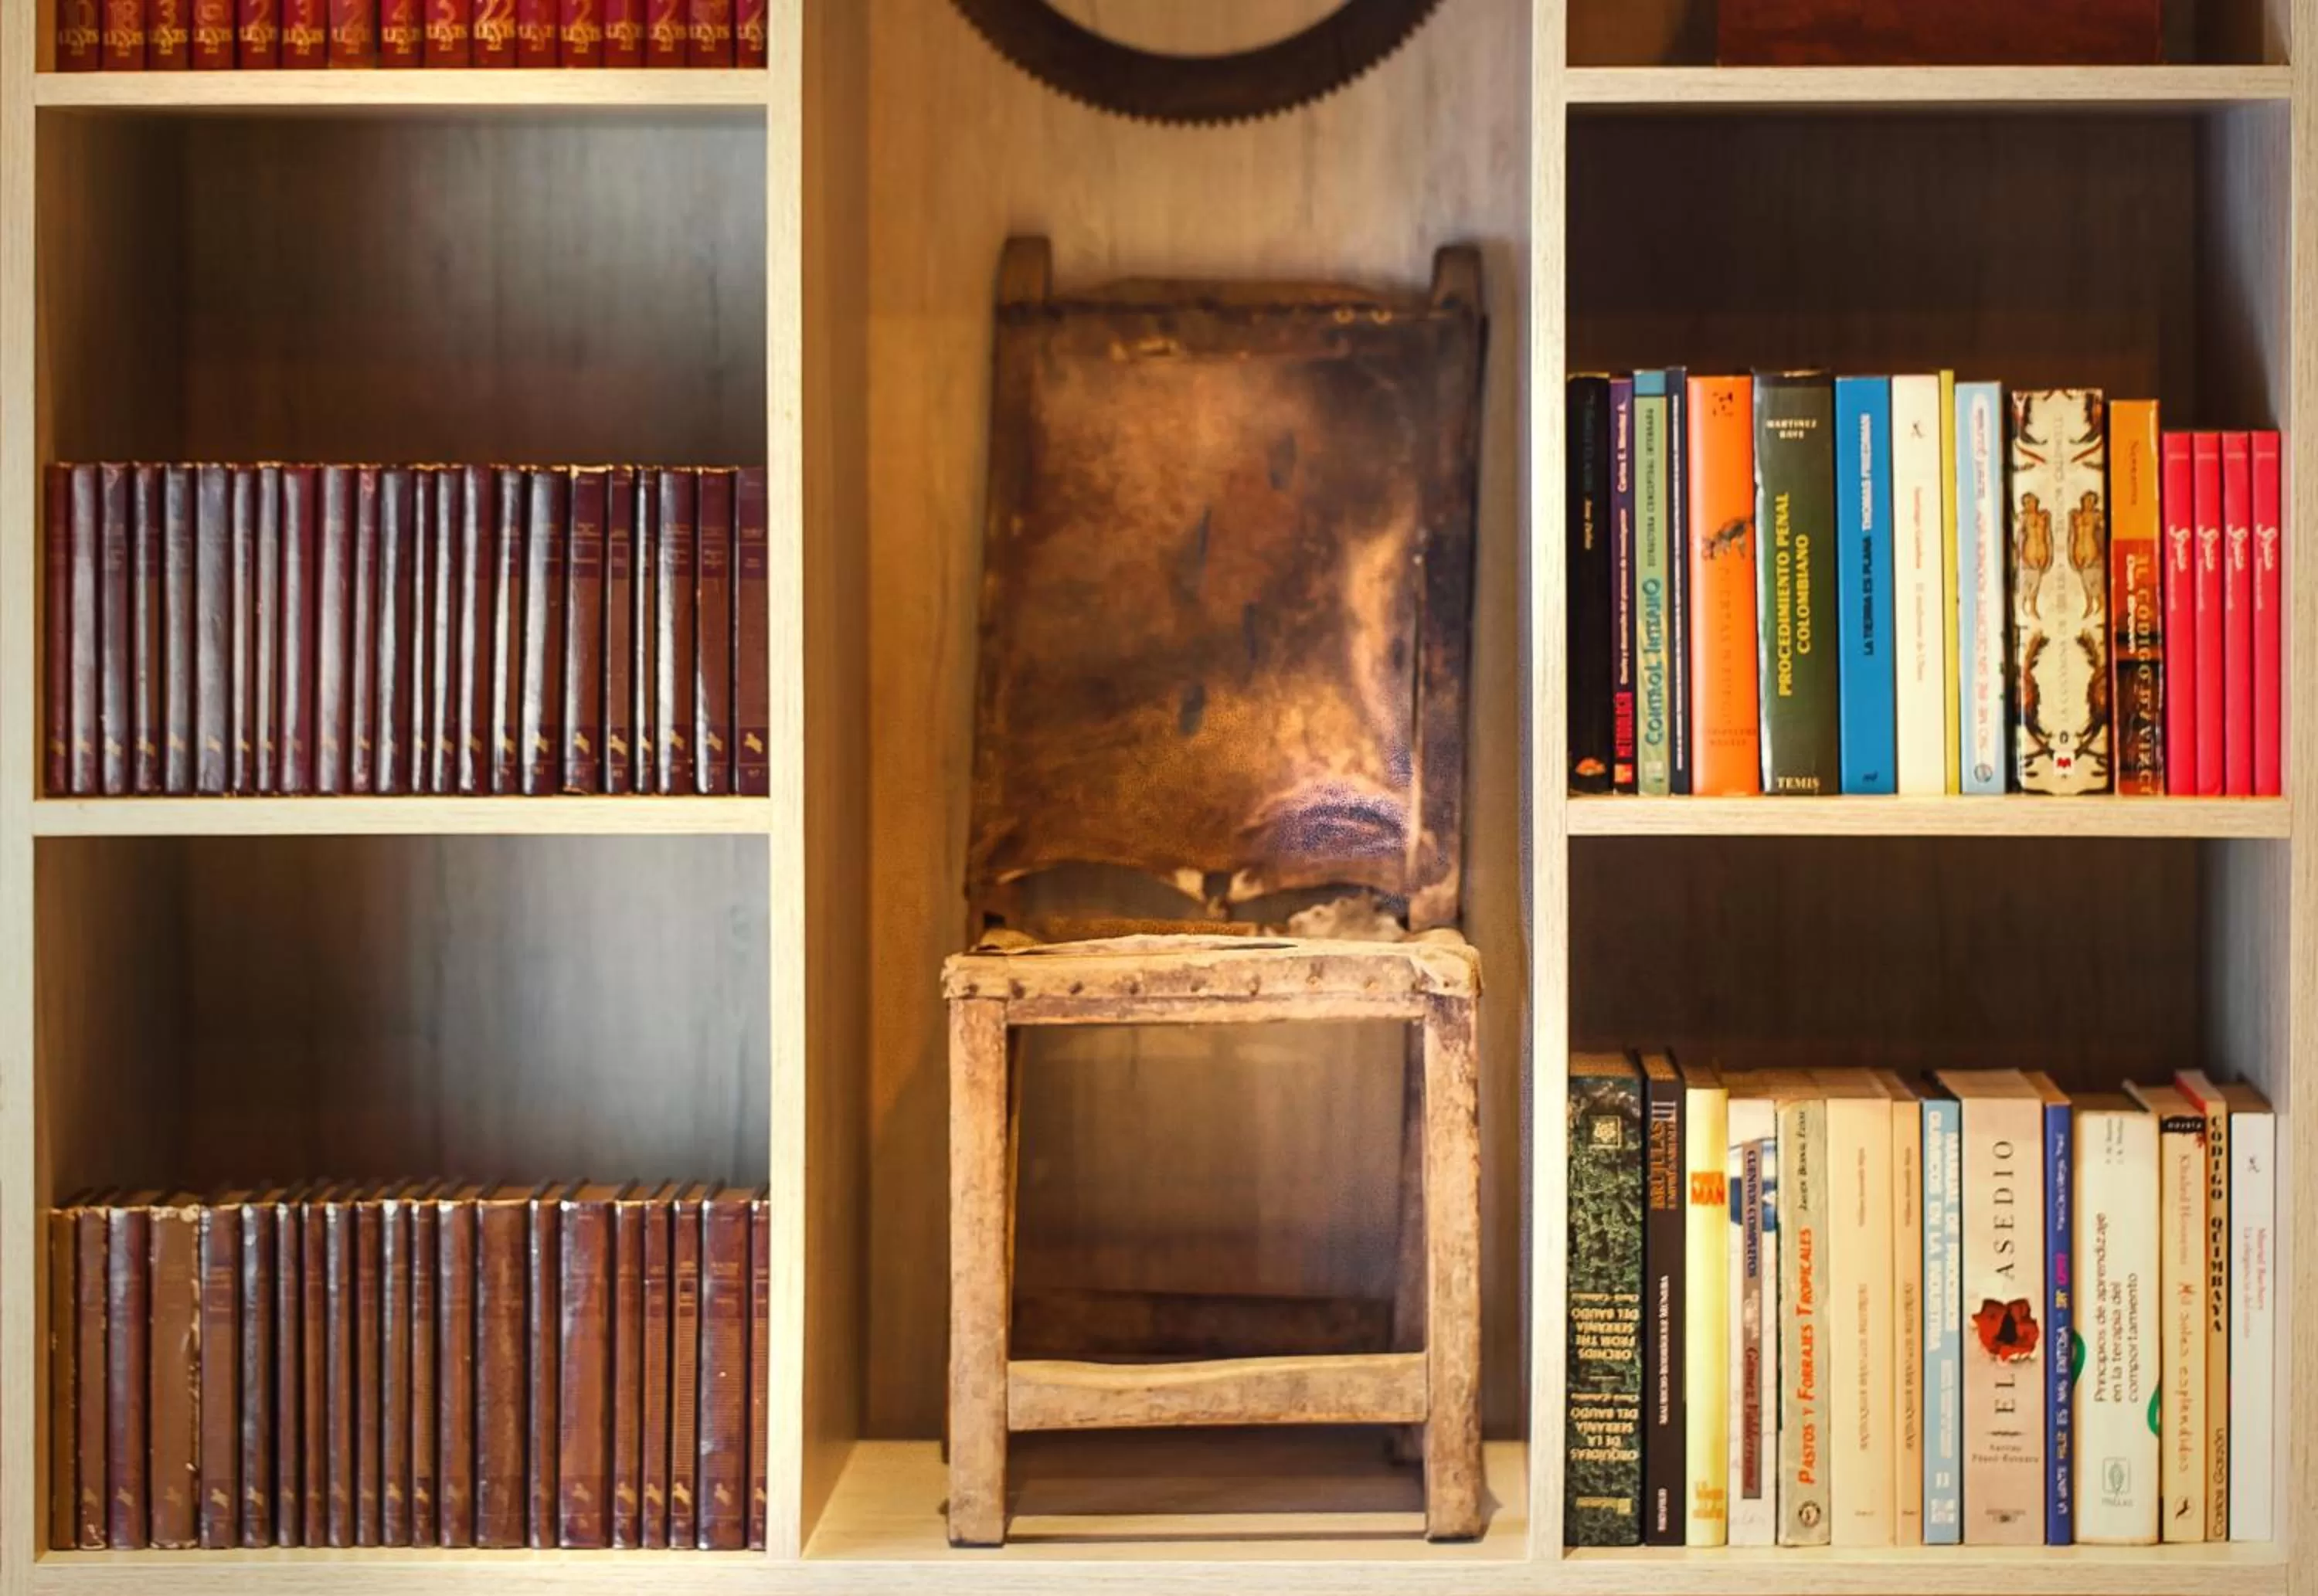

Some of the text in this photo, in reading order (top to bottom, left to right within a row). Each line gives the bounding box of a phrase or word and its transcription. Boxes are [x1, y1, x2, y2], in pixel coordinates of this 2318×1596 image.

[1775, 491, 1792, 697] PROCEDIMIENTO PENAL
[1795, 534, 1810, 654] COLOMBIANO
[1778, 776, 1820, 790] TEMIS
[1747, 1149, 1757, 1207] CUENTOS
[1747, 1207, 1759, 1279] COMPLETOS
[1794, 1228, 1814, 1317] TROPICALES
[1928, 1231, 1942, 1255] LA
[1993, 1139, 2016, 1414] EL ASEDIO
[1616, 1308, 1640, 1321] DEL
[2092, 1212, 2108, 1403] Principios de aprendizaje
[2180, 1312, 2193, 1358] soles
[1575, 1333, 1636, 1347] FROM THE
[1579, 1347, 1633, 1360] ORCHIDS
[1796, 1324, 1814, 1402] FORRAJES
[2109, 1281, 2123, 1404] en la terapia del
[2126, 1272, 2140, 1404] comportamiento
[1586, 1435, 1622, 1448] DE LA
[1616, 1408, 1639, 1420] DEL
[1798, 1423, 1817, 1484] PASTOS
[2213, 1488, 2225, 1537] Carlos
